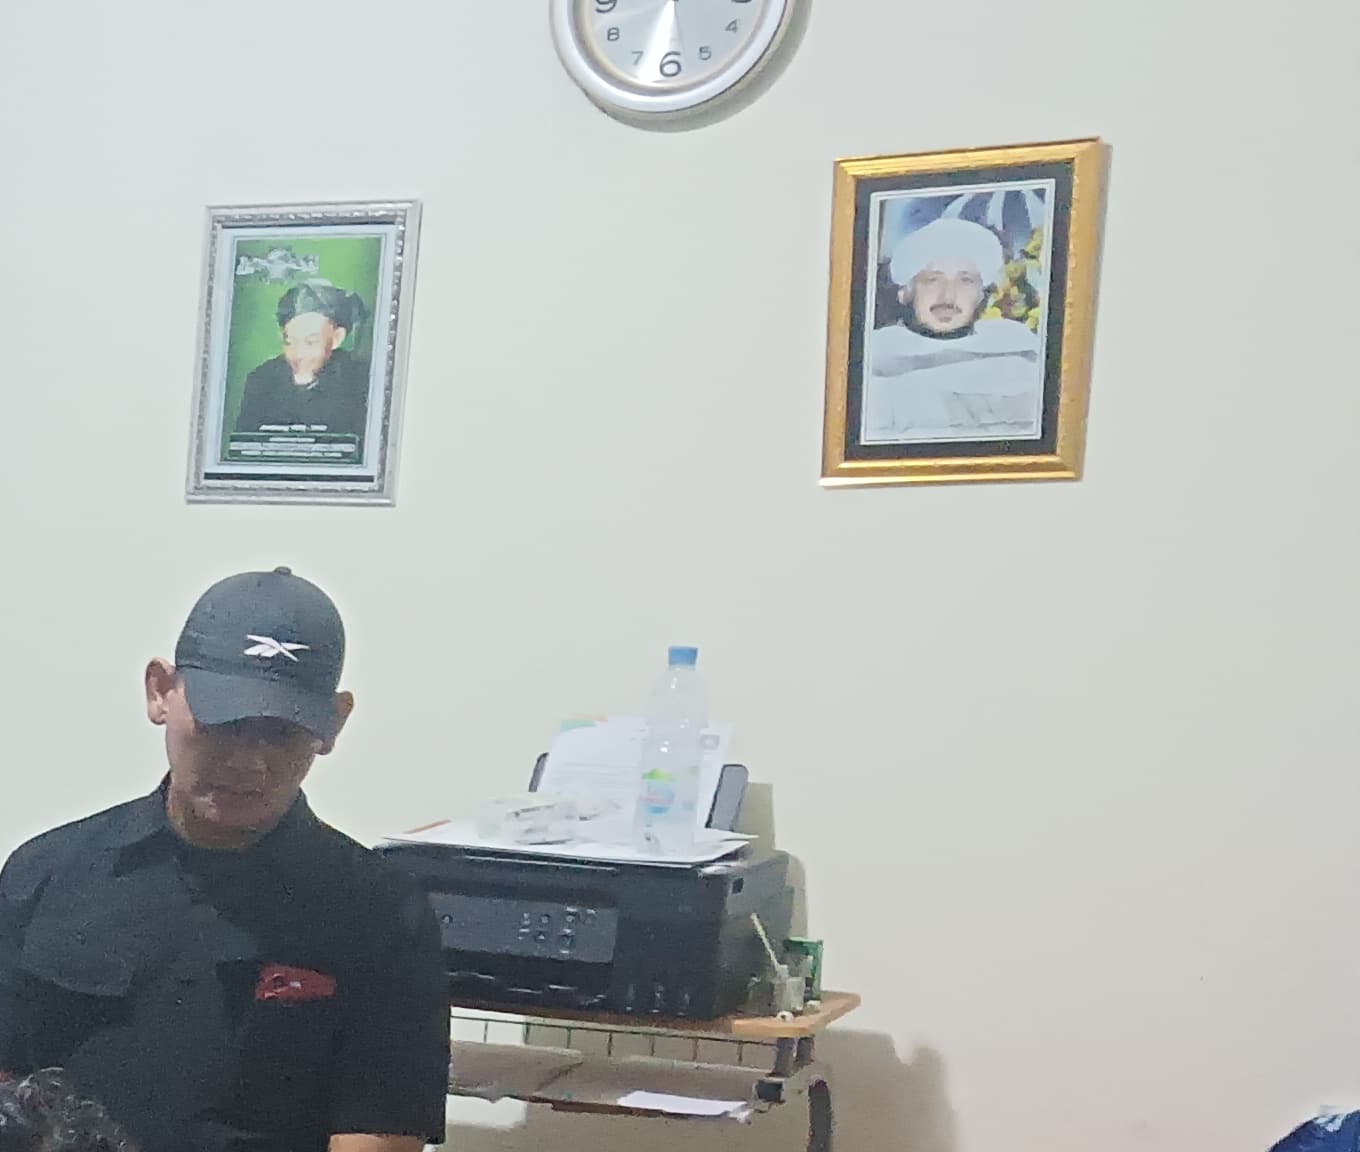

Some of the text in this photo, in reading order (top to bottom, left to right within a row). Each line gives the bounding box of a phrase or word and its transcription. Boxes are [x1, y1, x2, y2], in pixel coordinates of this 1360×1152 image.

[725, 19, 739, 33] 4
[606, 27, 621, 42] 8
[631, 51, 644, 66] 7
[698, 46, 712, 61] 5
[659, 51, 682, 78] 6
